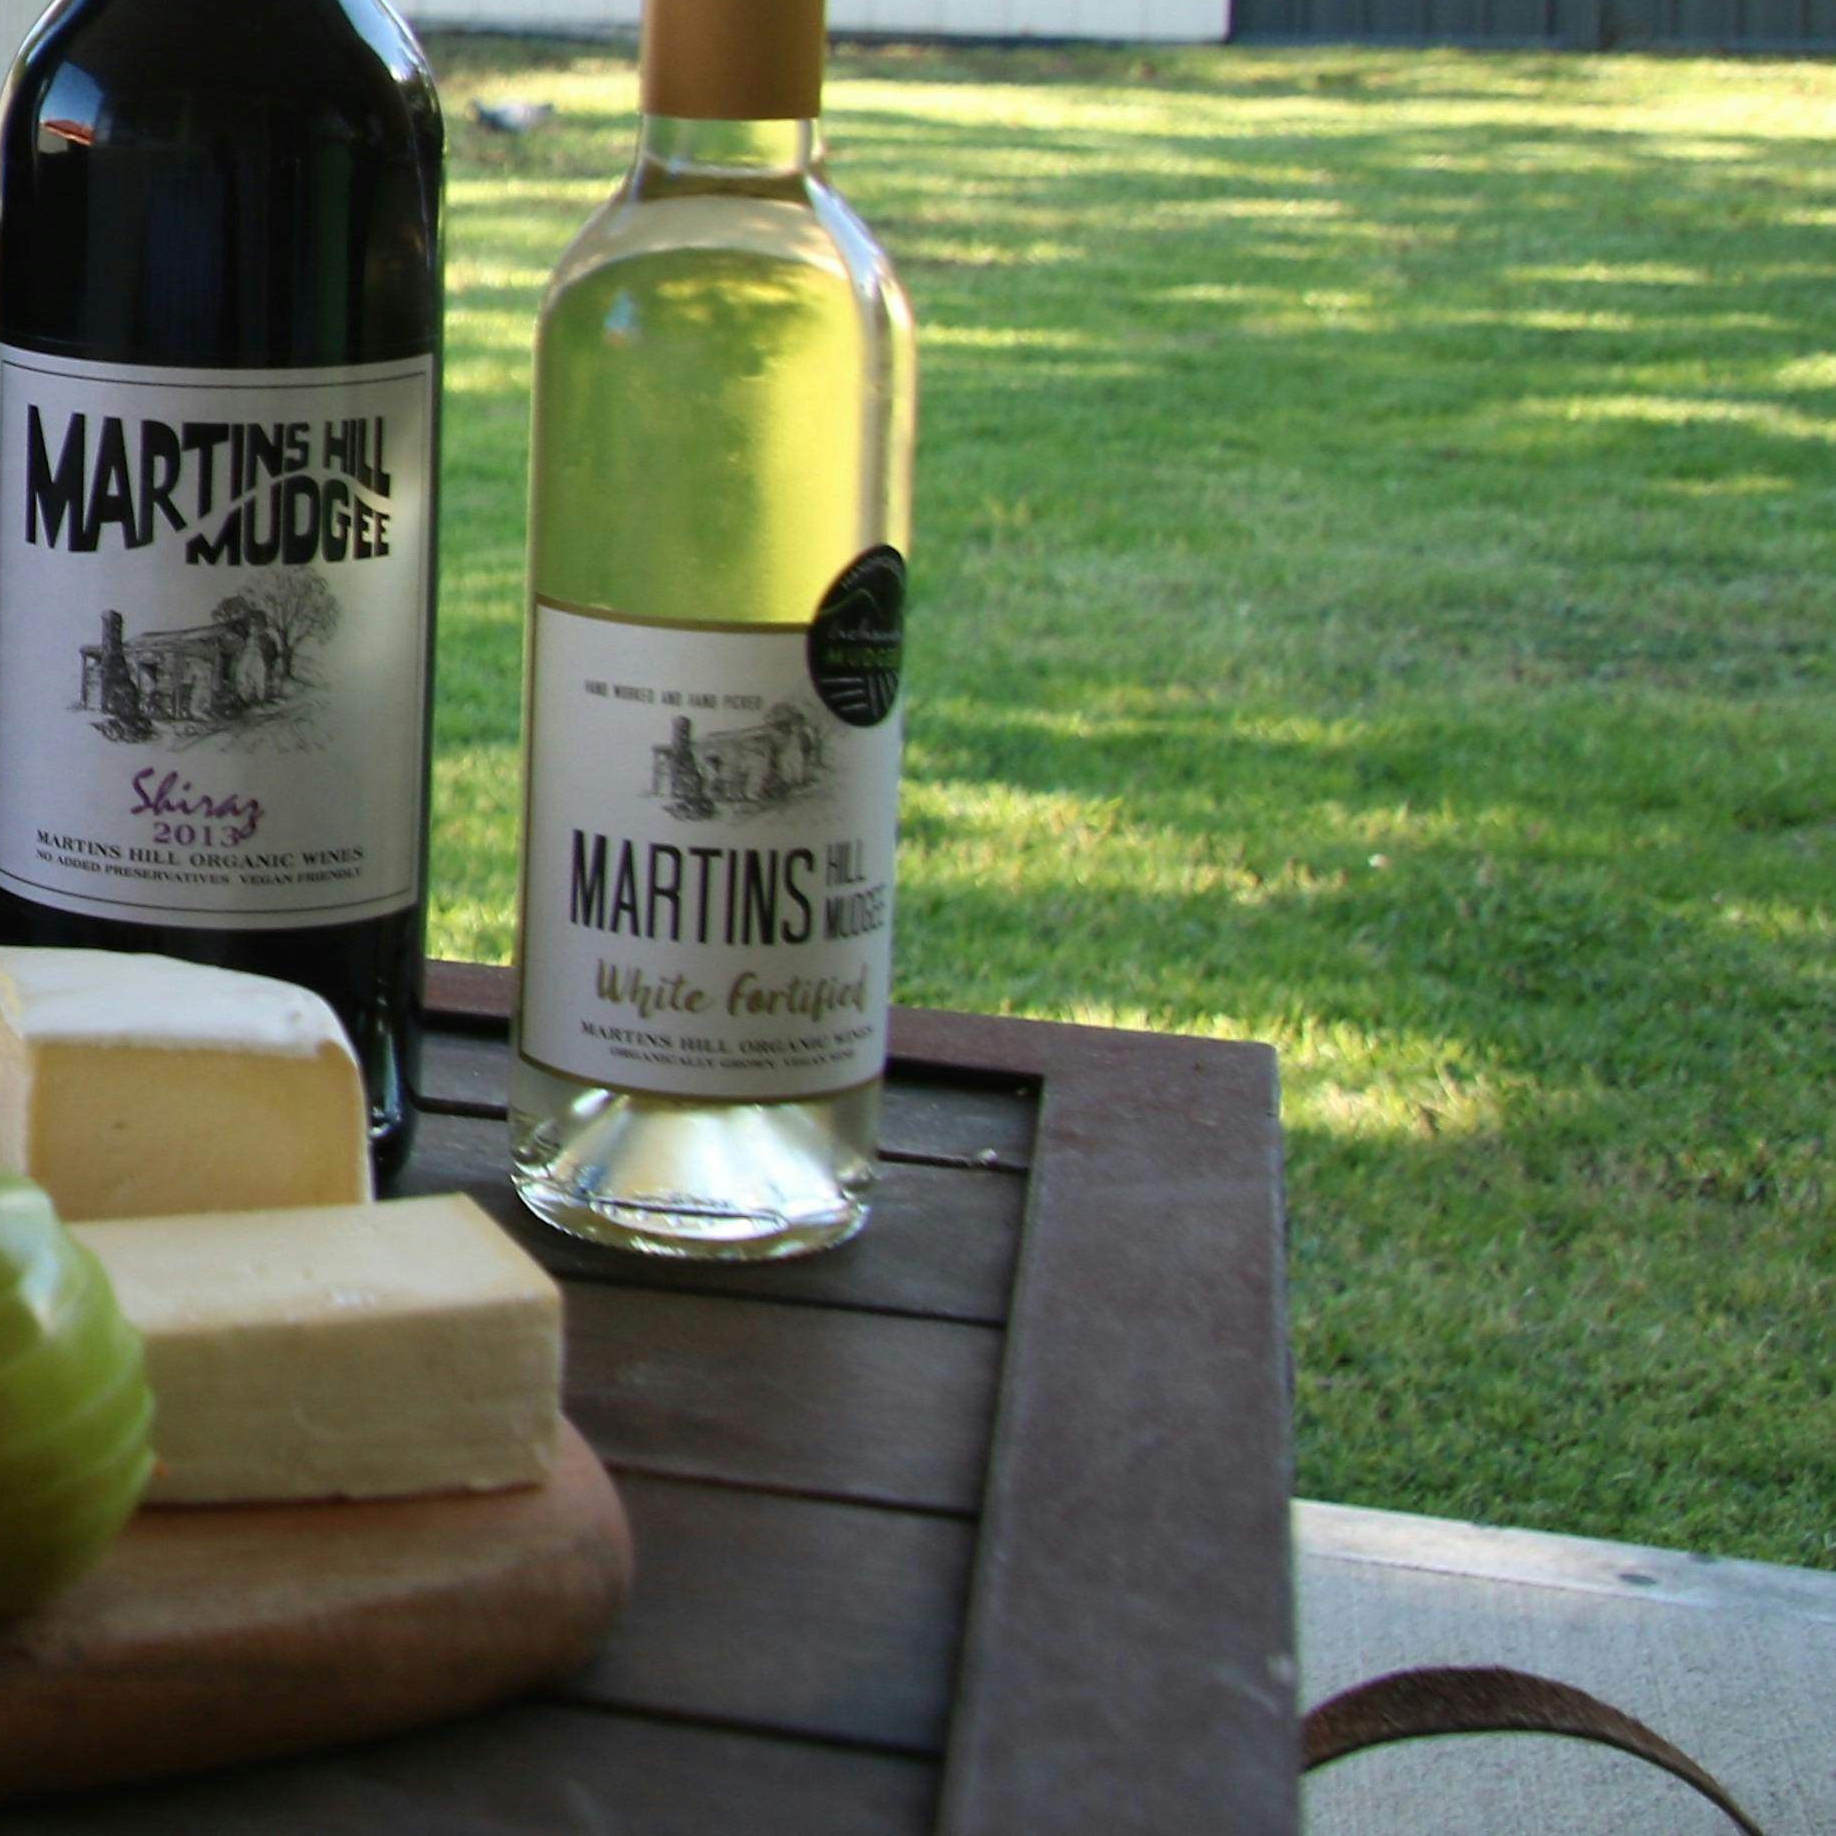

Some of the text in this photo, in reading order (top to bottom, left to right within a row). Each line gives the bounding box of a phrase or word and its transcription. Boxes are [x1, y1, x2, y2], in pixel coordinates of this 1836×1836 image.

[25, 403, 390, 553] MARTINS HILL
[185, 475, 390, 565] MUDGEE
[131, 766, 264, 839] Shiraz
[153, 822, 241, 847] 2013
[36, 829, 364, 869] MARTINS HILL ORGANIC WINES
[570, 829, 815, 946] MARTINS
[595, 958, 708, 1019] White
[581, 1020, 672, 1048] MARTINS
[681, 1037, 727, 1053] HILL
